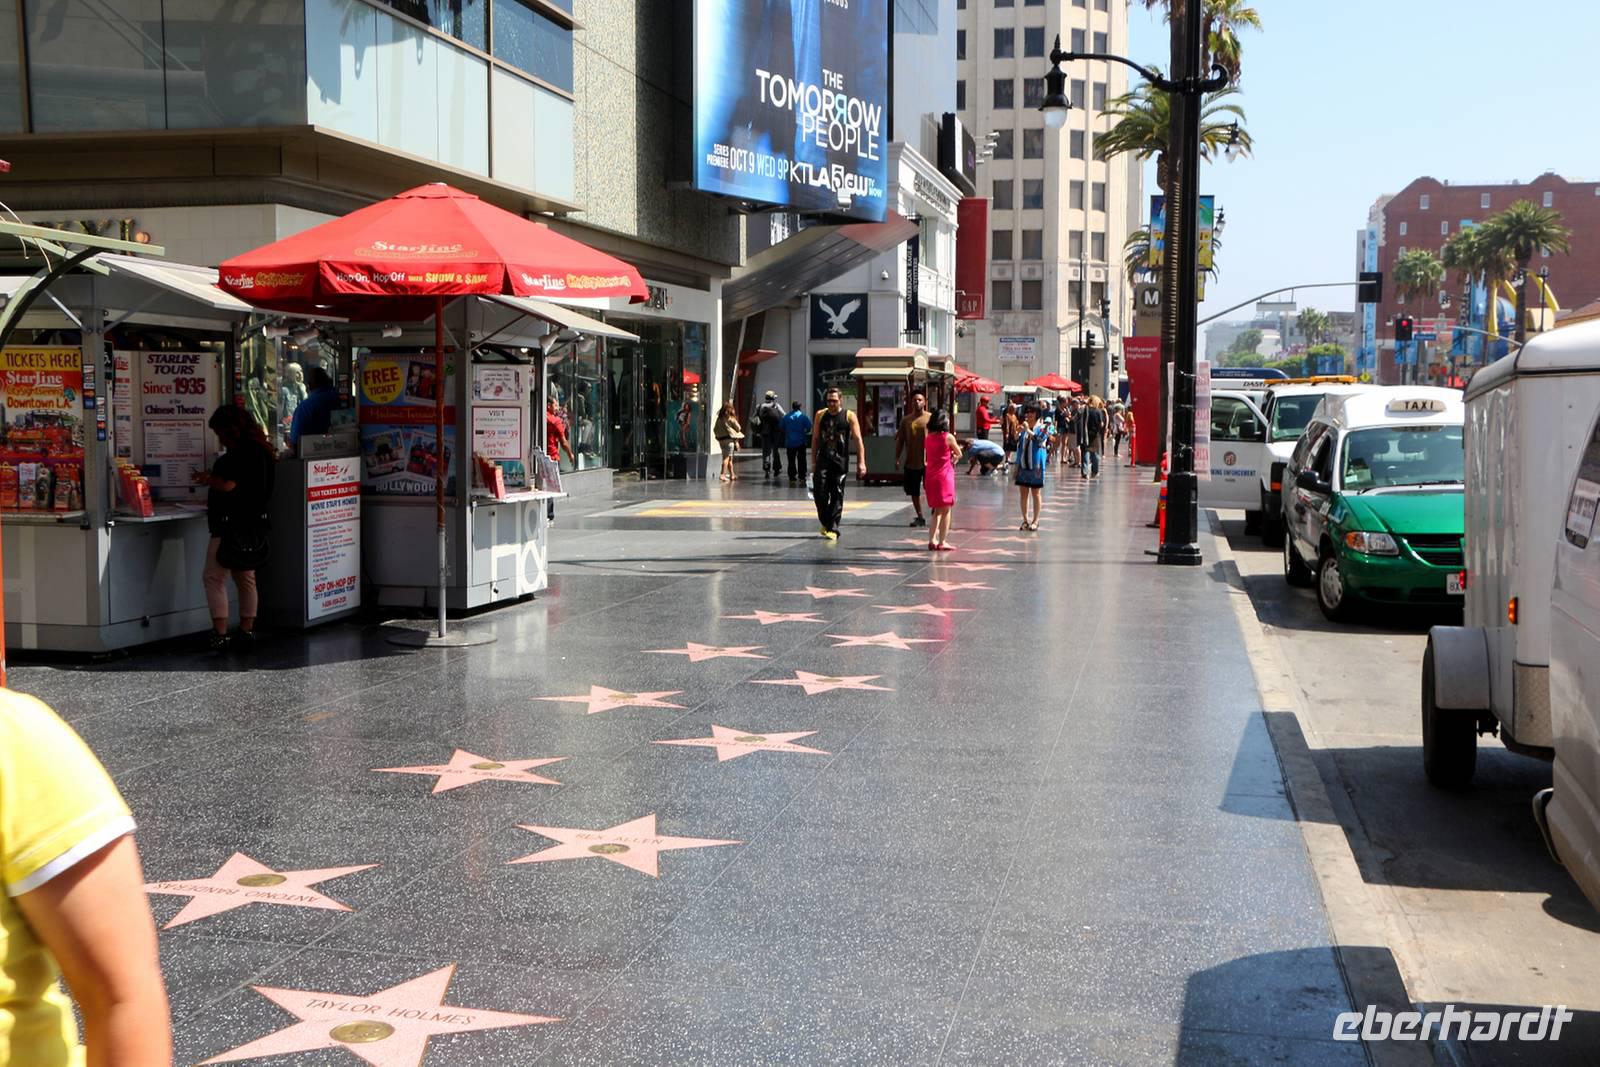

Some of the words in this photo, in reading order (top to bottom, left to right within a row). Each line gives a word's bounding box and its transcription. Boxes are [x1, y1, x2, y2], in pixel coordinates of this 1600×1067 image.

[823, 68, 843, 90] THE
[755, 69, 881, 134] TOMORROW
[803, 111, 879, 160] PEOPLE
[713, 144, 729, 157] SERIES
[706, 155, 729, 169] PREMIERE
[730, 147, 748, 172] OCT
[748, 152, 754, 173] 9
[757, 154, 776, 178] WED
[778, 158, 789, 181] 9P
[425, 271, 455, 282] SHOW
[455, 273, 463, 281] &
[464, 272, 489, 283] SAVE
[960, 300, 978, 312] GAP
[5, 353, 47, 367] TICKETS
[49, 353, 79, 367] HERE
[147, 354, 201, 364] STARLINE
[154, 365, 195, 375] TOURS
[363, 366, 400, 386] FREE
[143, 381, 172, 394] Since
[173, 377, 206, 395] 1935
[368, 384, 397, 396] TICKET
[7, 396, 54, 408] Downtown
[1404, 401, 1434, 410] TAXI
[145, 405, 175, 414] Chinese
[175, 405, 205, 414] Theatre
[375, 479, 436, 492] HOLLYWOOD
[153, 882, 237, 896] BANDERAS
[244, 890, 320, 904] ANTONIO
[305, 999, 381, 1015] TAYLOR
[387, 1007, 477, 1026] HOLMES
